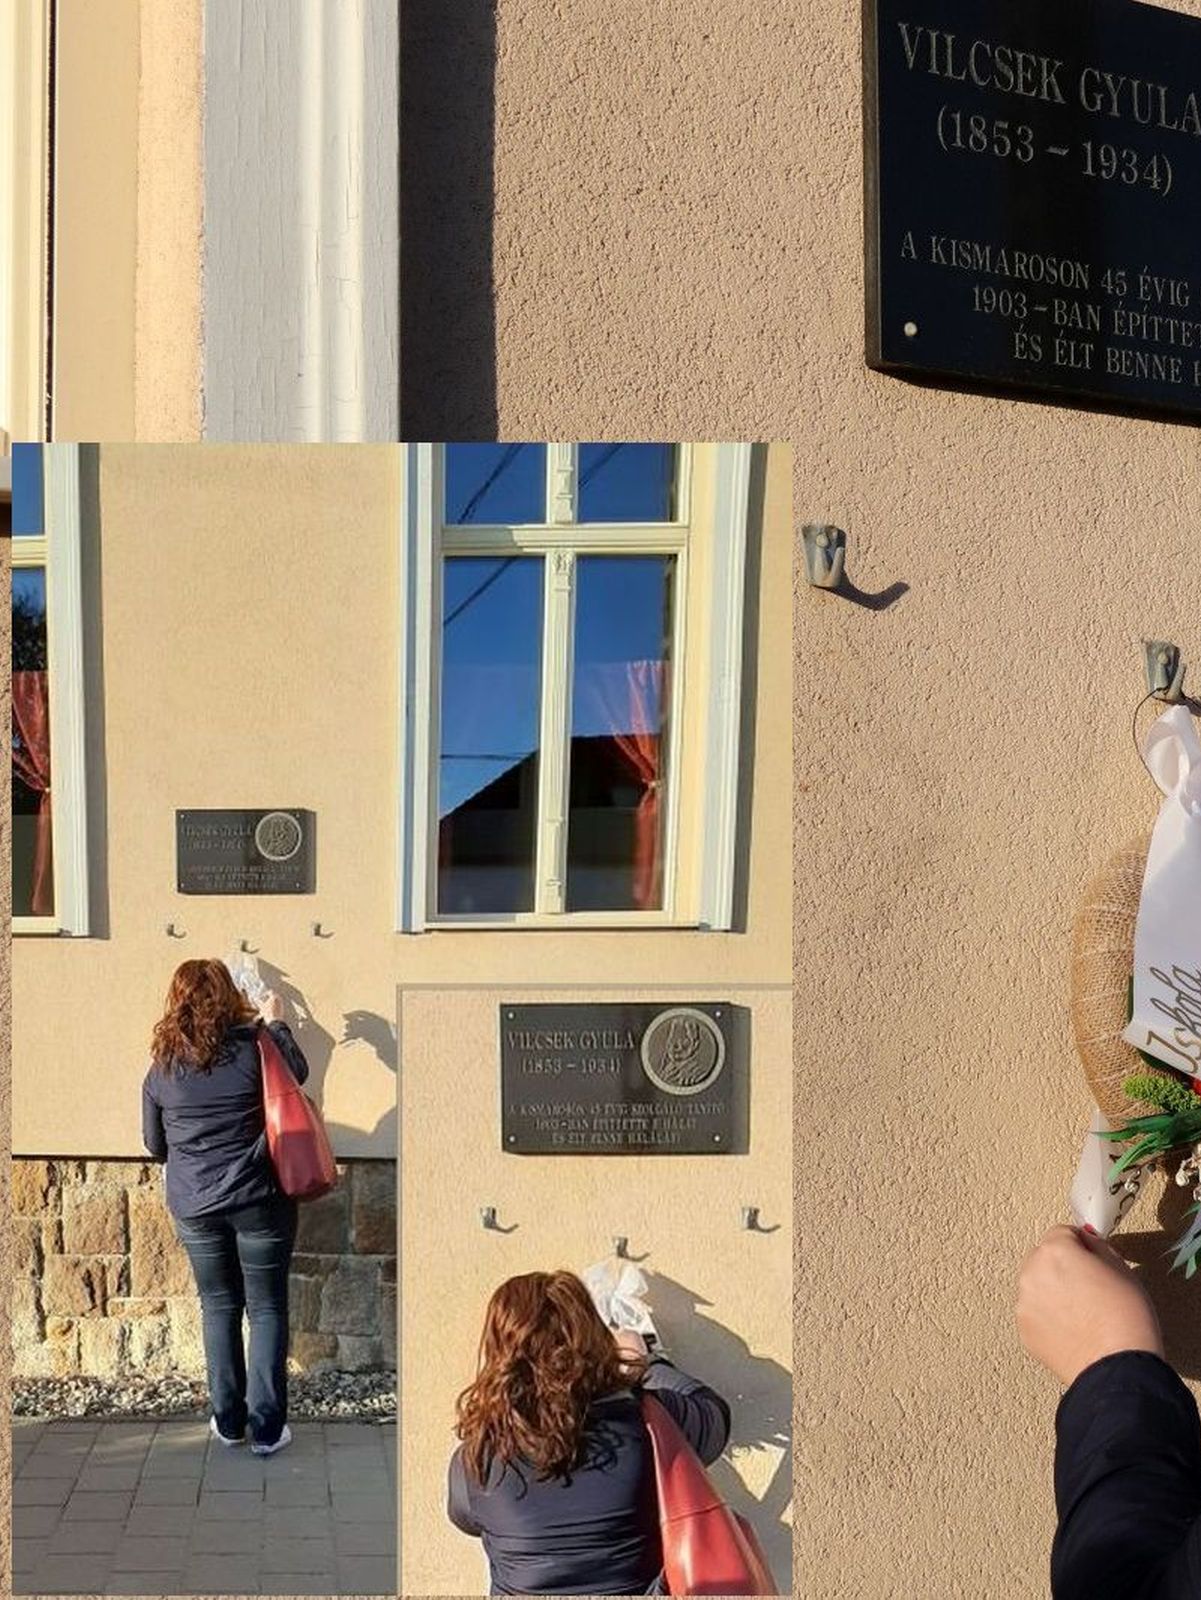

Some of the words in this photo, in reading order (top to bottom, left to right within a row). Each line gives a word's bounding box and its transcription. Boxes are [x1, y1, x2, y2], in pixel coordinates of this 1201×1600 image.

[898, 22, 1066, 104] VILCSEK
[937, 104, 1034, 163] (1853
[1082, 140, 1172, 196] 1934)
[900, 231, 918, 260] A
[930, 235, 1090, 290] KISMAROSON
[1101, 268, 1127, 297] 45
[1138, 265, 1190, 308] ÉVIG
[1013, 323, 1043, 362] ÉS
[1054, 329, 1095, 370] ÉLT
[1107, 347, 1183, 384] BENNE
[508, 1030, 576, 1051] VILCSEK
[580, 1030, 635, 1051] GYULA
